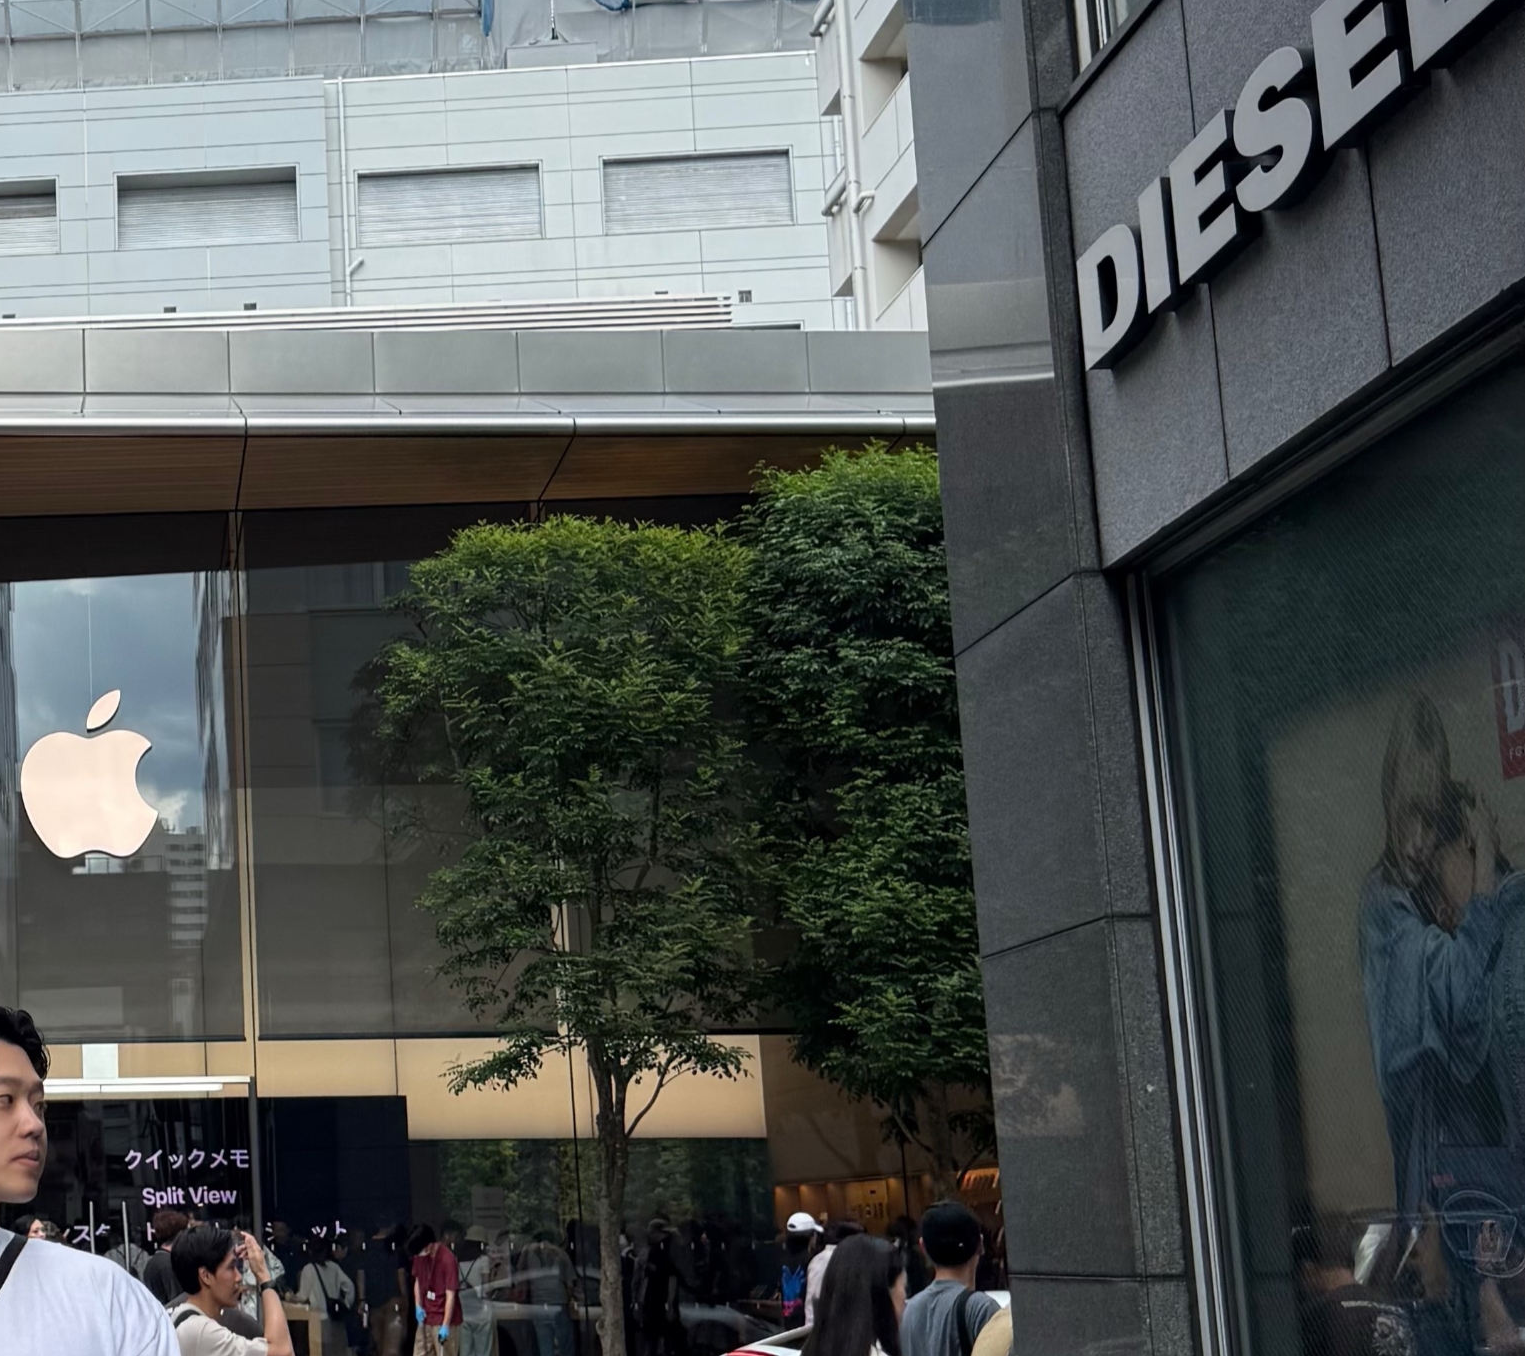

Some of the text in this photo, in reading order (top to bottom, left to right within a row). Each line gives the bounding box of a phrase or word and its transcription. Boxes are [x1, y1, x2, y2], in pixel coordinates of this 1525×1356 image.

[124, 1148, 250, 1171] クイックメモ
[142, 1186, 237, 1209] Split View
